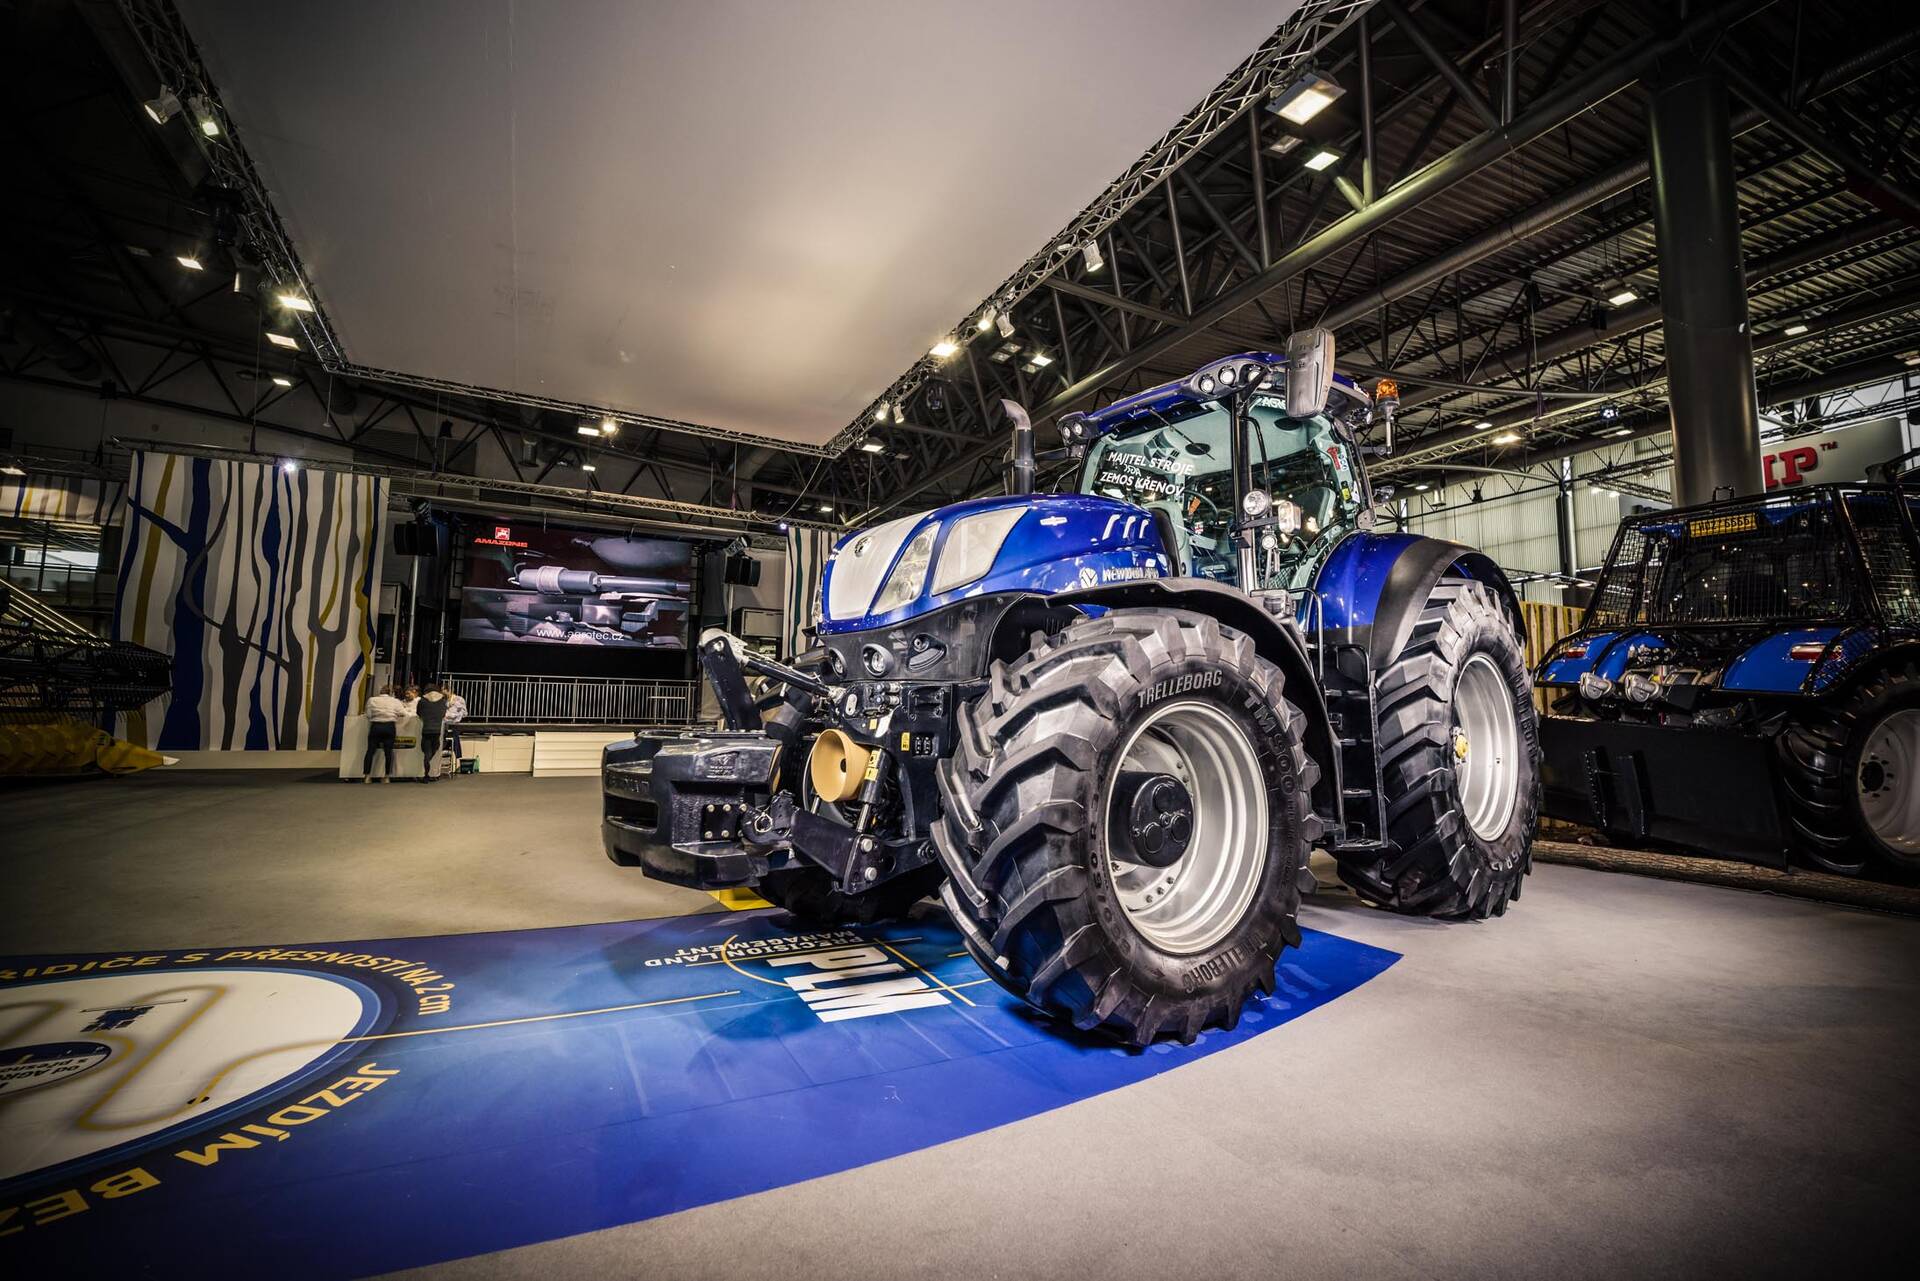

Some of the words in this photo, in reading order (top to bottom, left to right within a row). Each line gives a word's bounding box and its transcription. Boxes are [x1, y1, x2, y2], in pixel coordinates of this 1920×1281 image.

[1107, 452, 1147, 466] MAJITEL
[1149, 458, 1195, 475] STROJE
[1100, 472, 1135, 487] ZEMOS
[474, 537, 528, 547] AMAZONE
[536, 628, 625, 641] www.agrotec.cz
[1137, 669, 1223, 708] TRELLEBORG
[174, 953, 210, 963] S
[214, 948, 426, 973] PŘESNOSTÍ
[644, 953, 719, 967] LAND
[393, 967, 444, 986] NA
[414, 983, 455, 994] 2
[417, 995, 451, 1015] cm
[175, 1063, 400, 1166] JEZDÍM
